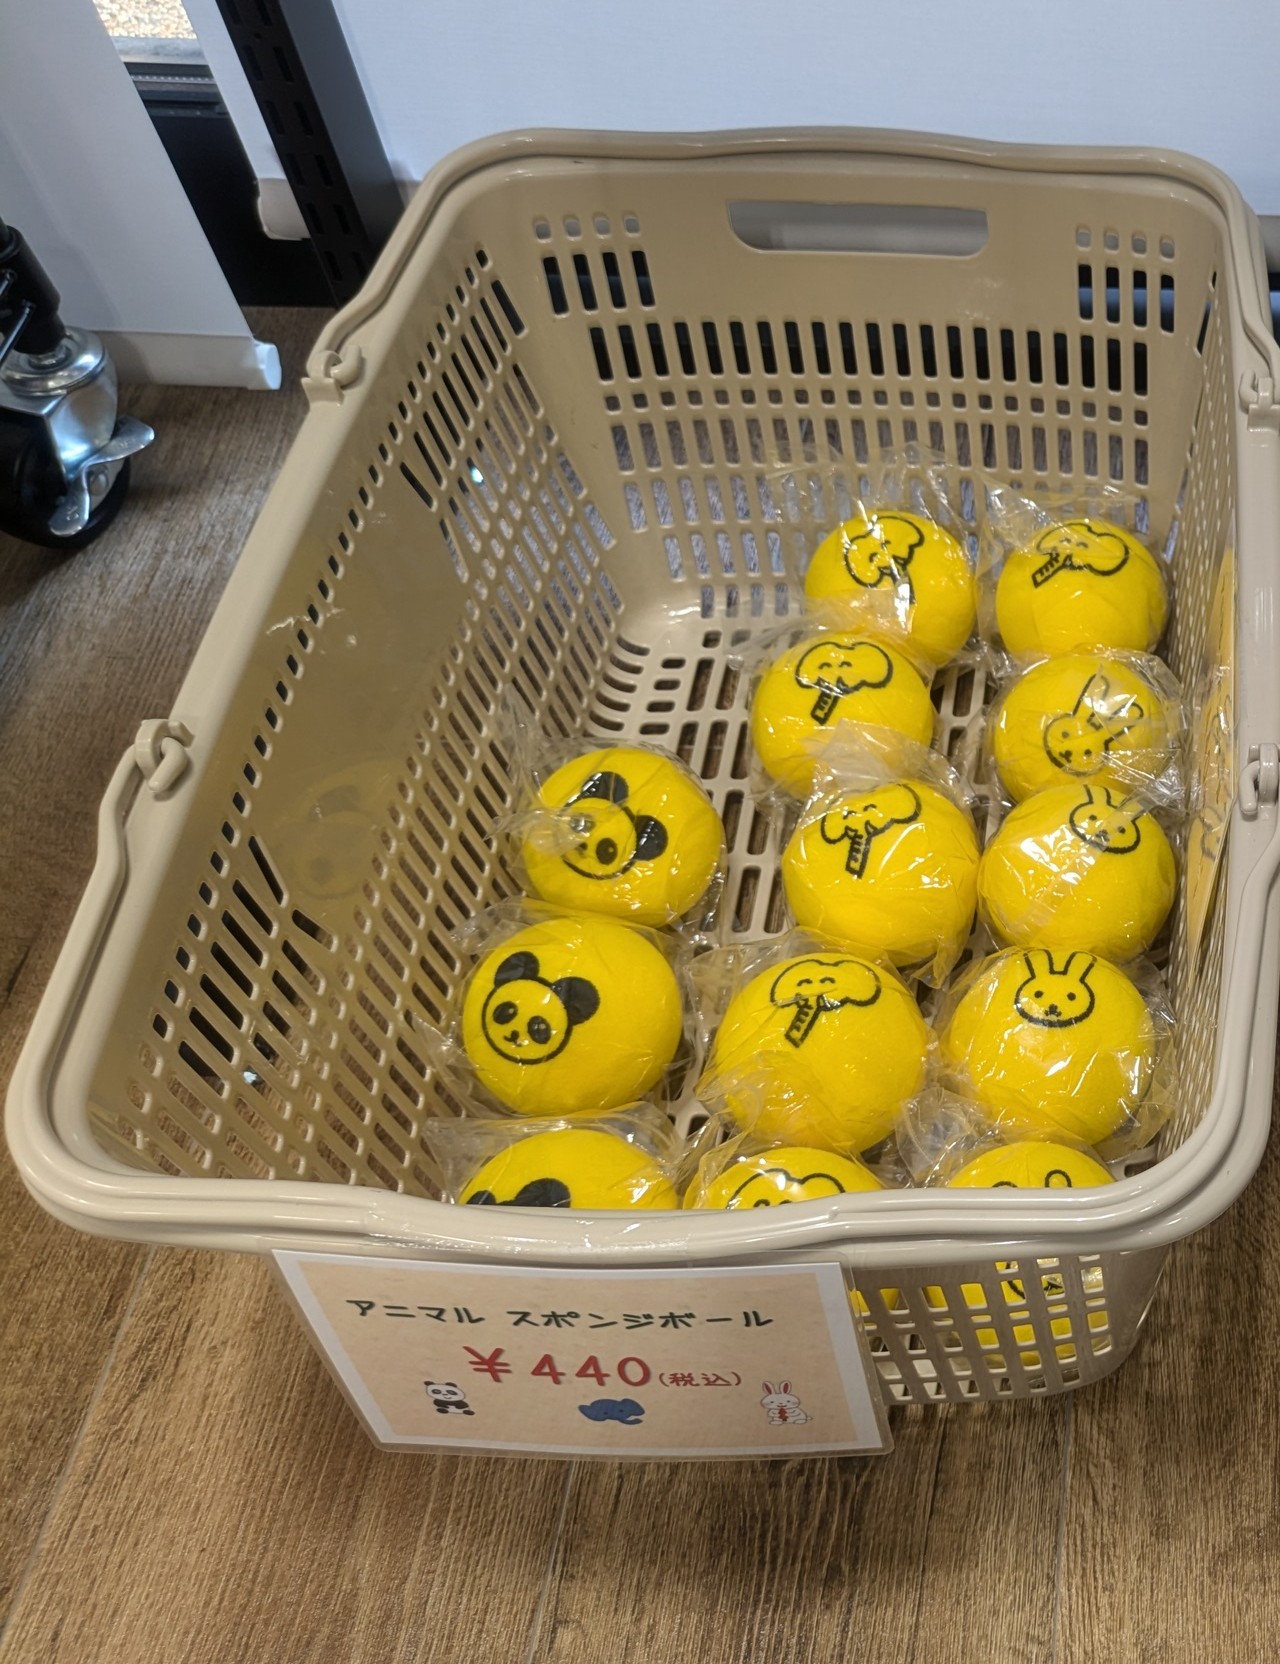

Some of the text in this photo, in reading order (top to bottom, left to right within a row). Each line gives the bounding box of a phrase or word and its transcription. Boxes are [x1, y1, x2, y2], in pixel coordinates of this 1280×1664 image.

[346, 1299, 774, 1331] アニマル スポンジボール
